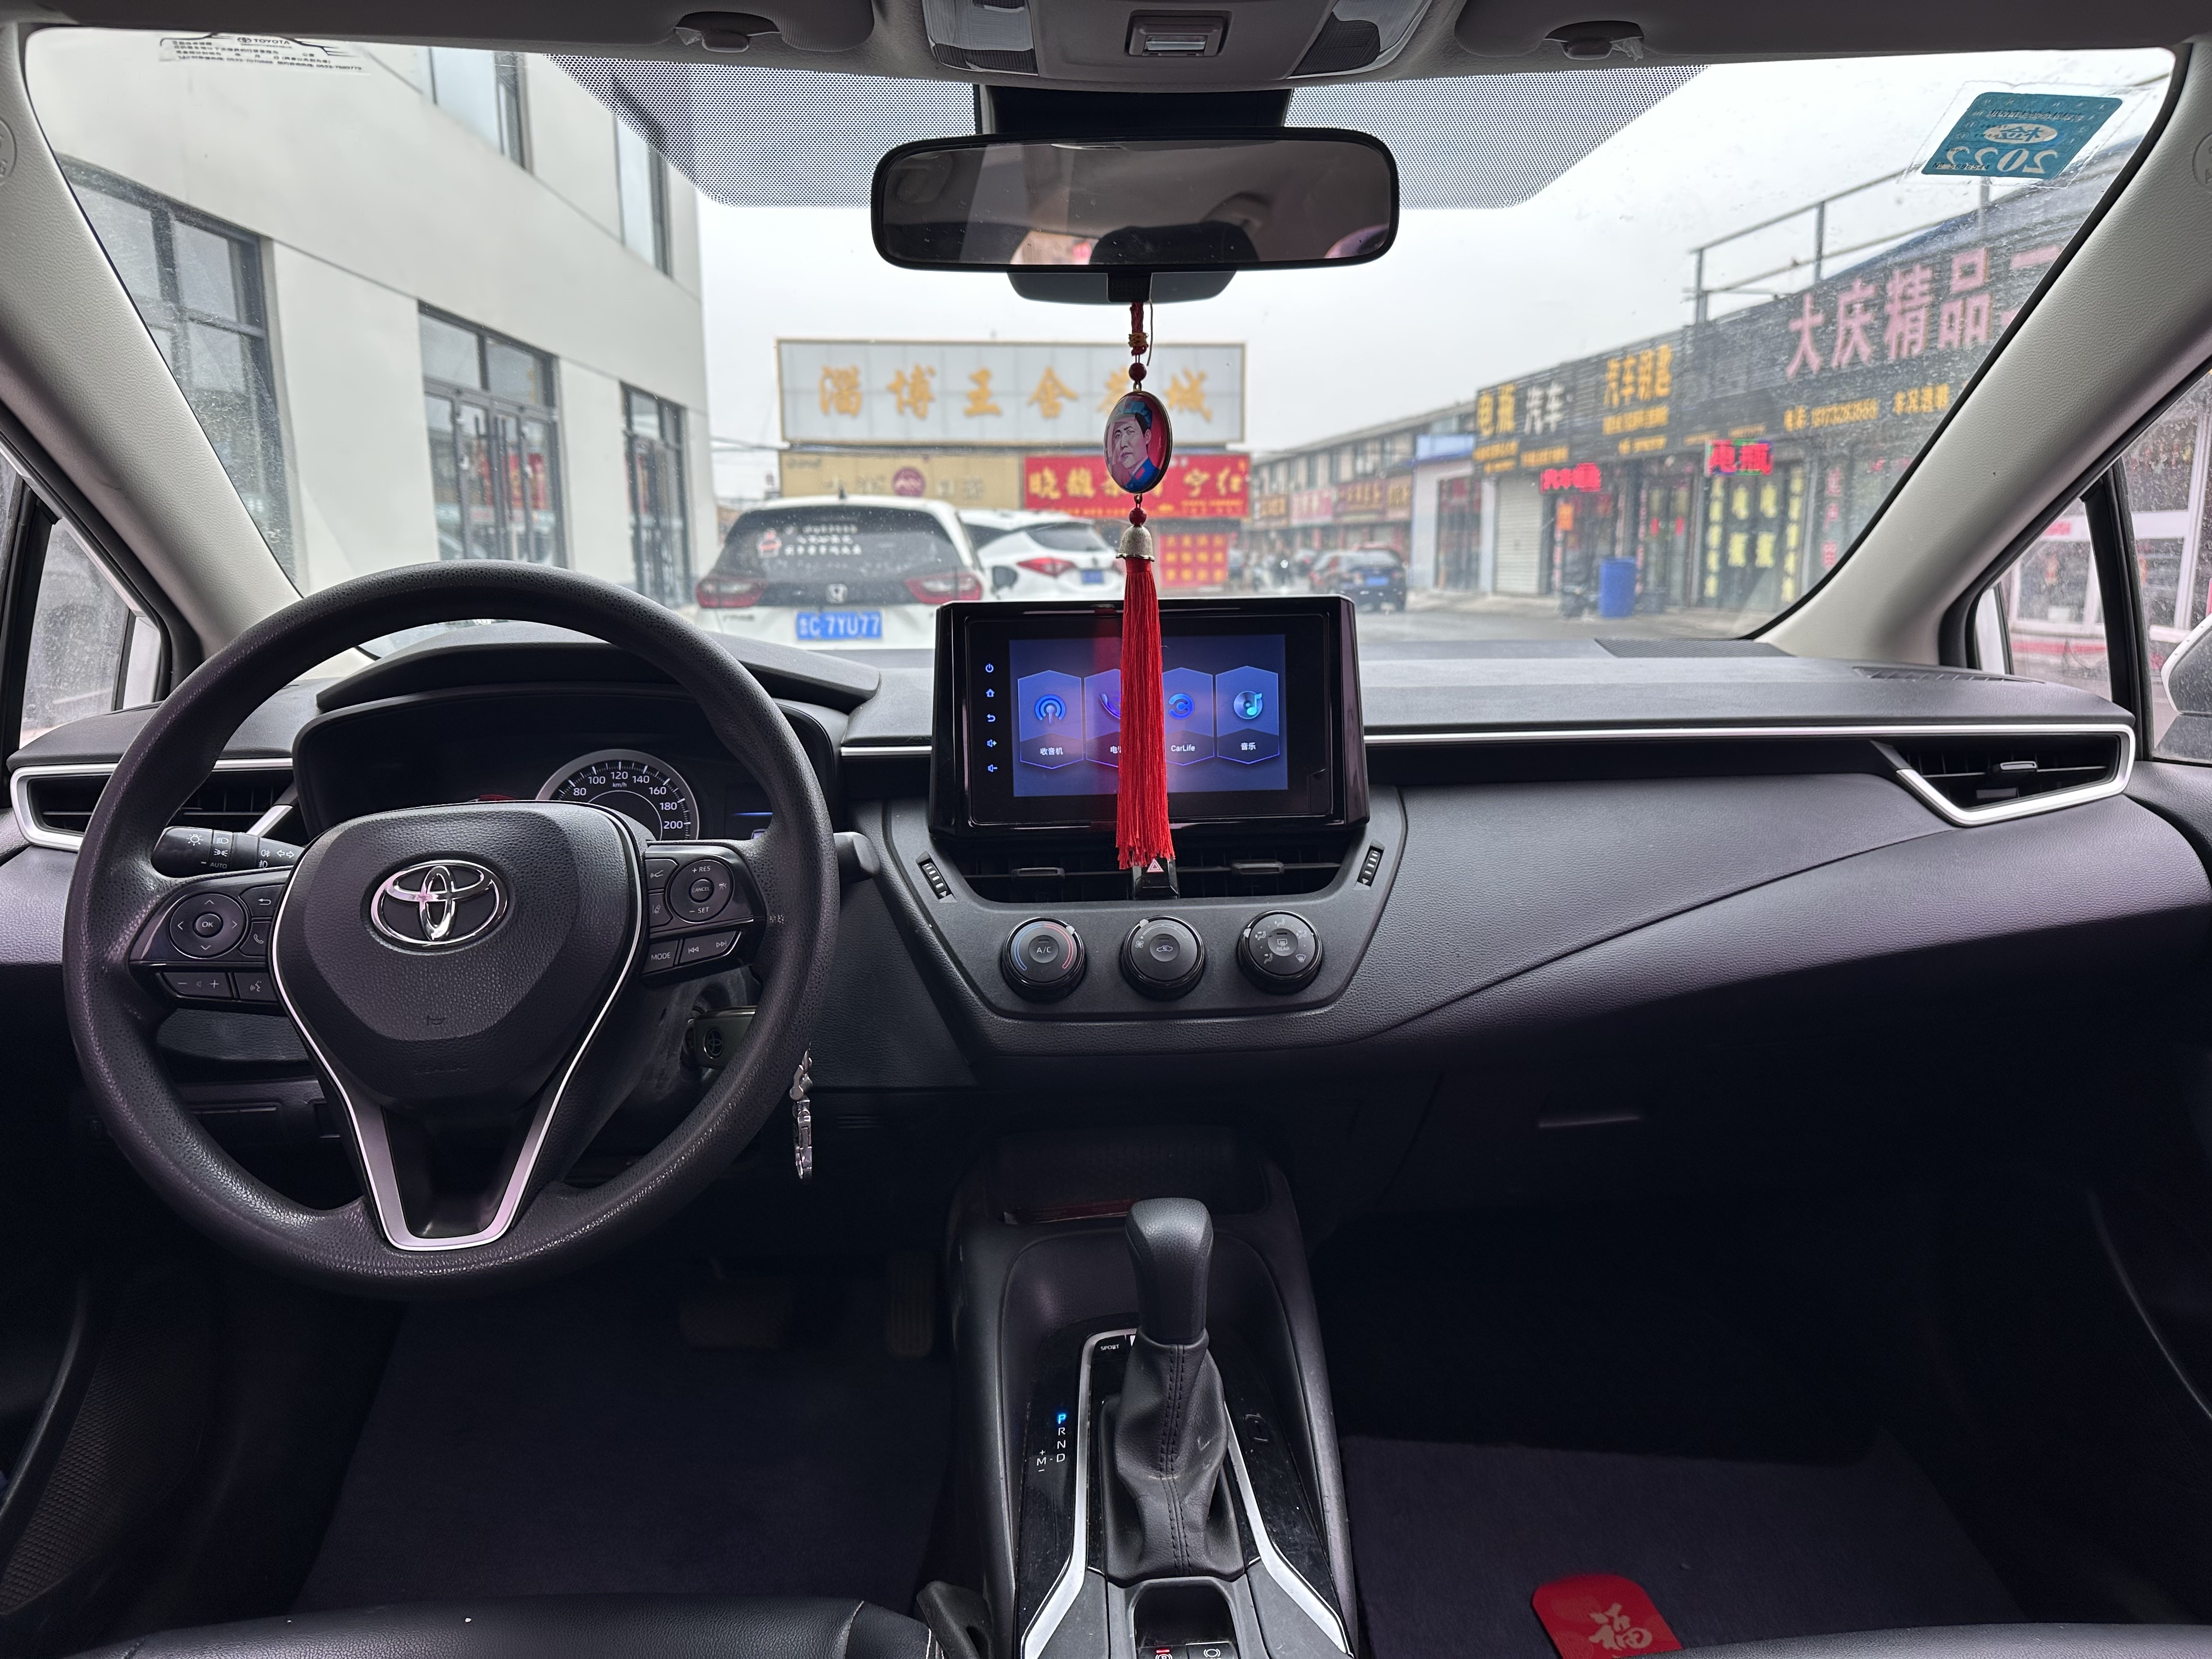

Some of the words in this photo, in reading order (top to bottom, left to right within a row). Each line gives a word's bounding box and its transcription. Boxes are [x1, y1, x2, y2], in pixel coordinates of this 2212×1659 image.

[1040, 747, 1063, 756] 收音机
[1171, 744, 1195, 752] CarLife
[1240, 742, 1256, 751] 音乐
[588, 776, 606, 786] 100
[610, 771, 629, 781] 120
[632, 774, 650, 785] 140
[573, 787, 586, 797] 80
[649, 786, 667, 796] 160
[659, 801, 678, 811] 180
[663, 820, 684, 830] 200
[210, 861, 228, 870] AUTO
[1058, 1414, 1066, 1424] P
[1058, 1427, 1066, 1436] R
[1057, 1440, 1066, 1449] N
[1036, 1457, 1047, 1466] M
[1056, 1453, 1065, 1463] D
